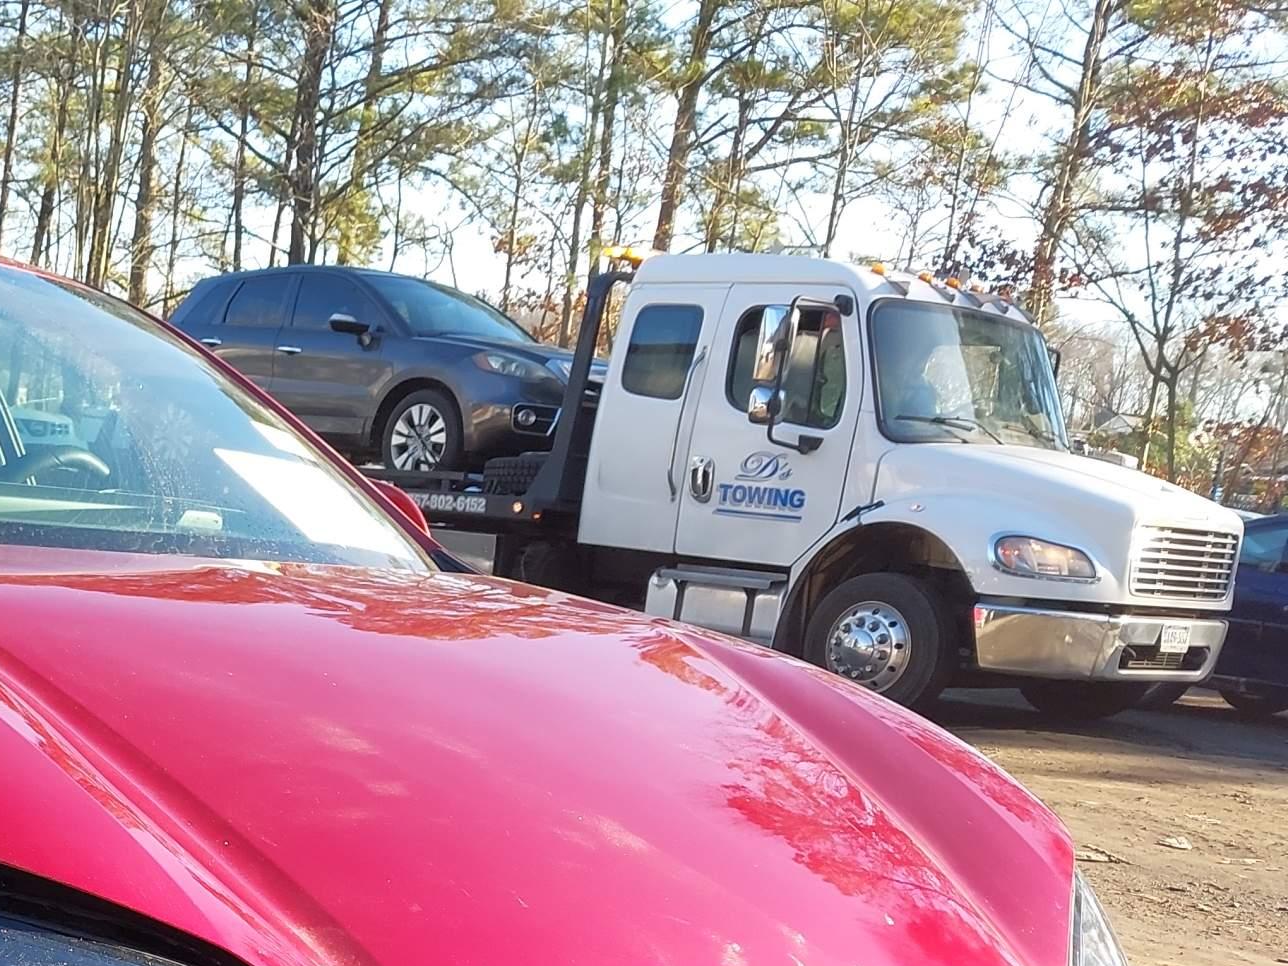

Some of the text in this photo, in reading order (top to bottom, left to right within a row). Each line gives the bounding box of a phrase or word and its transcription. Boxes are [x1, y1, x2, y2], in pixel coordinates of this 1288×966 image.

[734, 450, 793, 482] D's
[408, 492, 487, 513] 57-802-6152
[718, 484, 806, 510] TOWING
